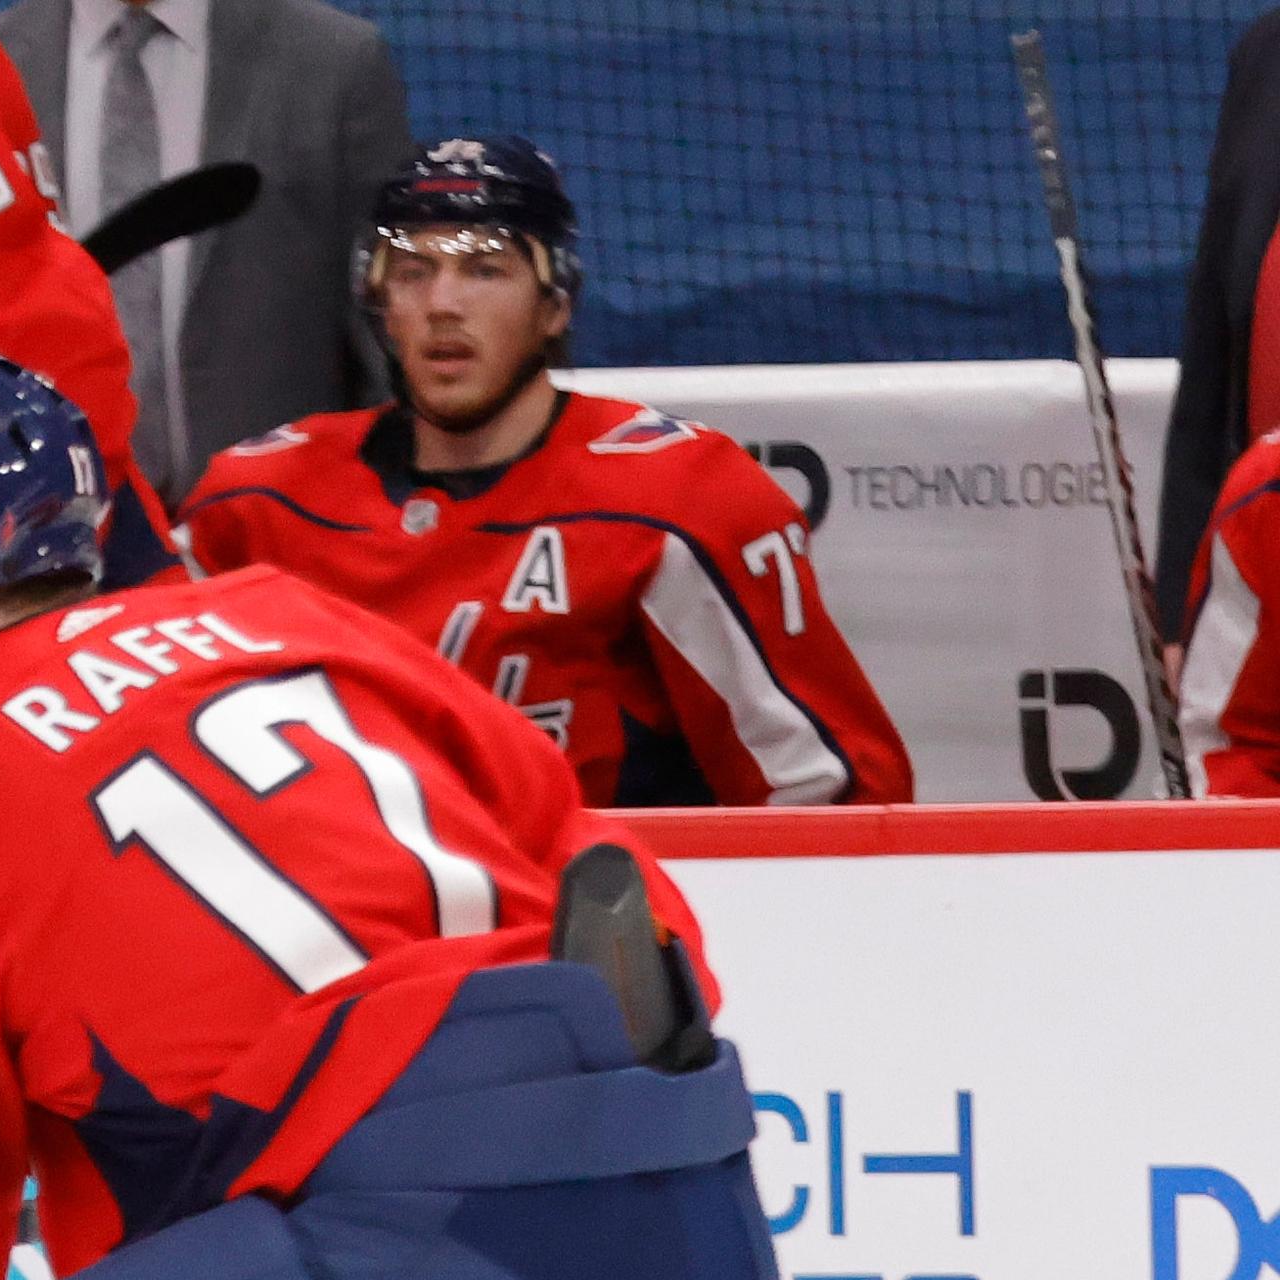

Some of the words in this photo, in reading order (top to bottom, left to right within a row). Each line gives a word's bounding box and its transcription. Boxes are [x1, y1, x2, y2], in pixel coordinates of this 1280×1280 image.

[500, 525, 572, 614] A
[0, 610, 286, 756] RAFFL
[90, 664, 500, 996] 17
